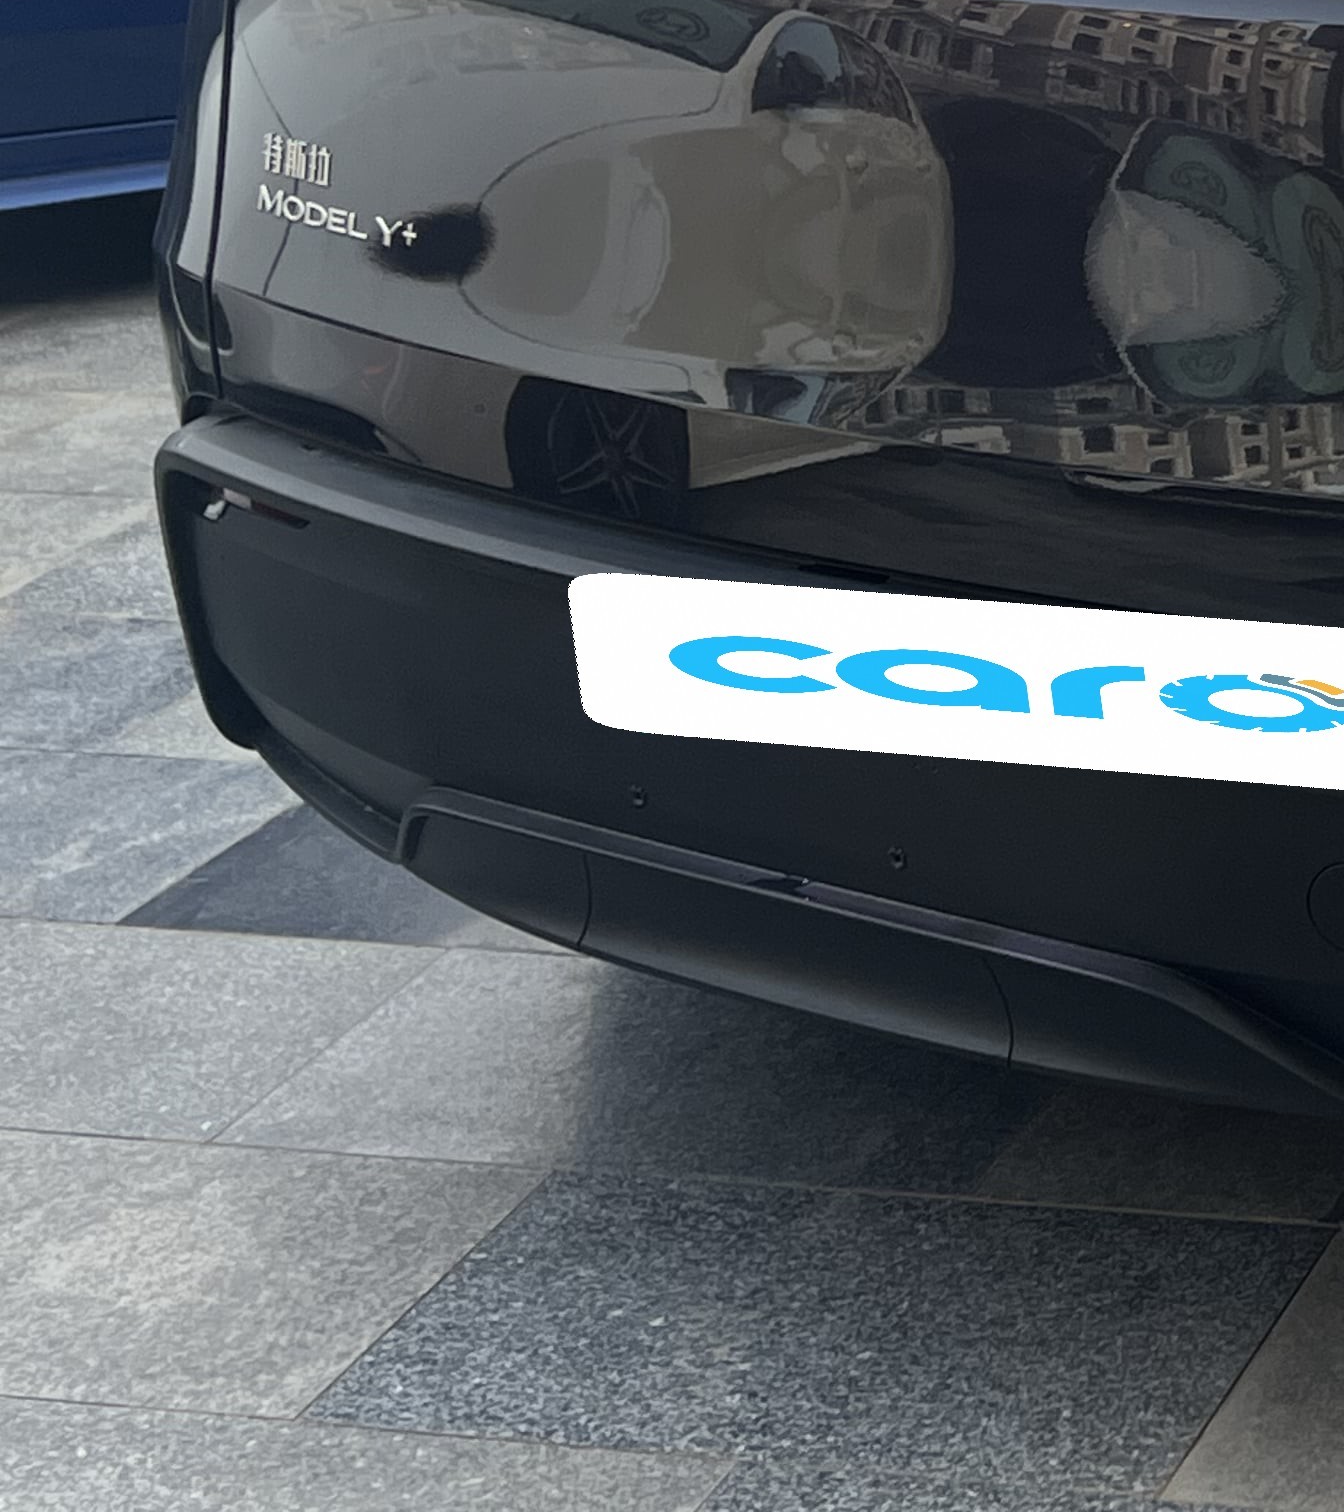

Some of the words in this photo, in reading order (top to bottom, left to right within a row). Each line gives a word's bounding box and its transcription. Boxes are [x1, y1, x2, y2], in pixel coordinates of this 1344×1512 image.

[262, 132, 333, 186] 特斯拉
[257, 184, 368, 240] MODEL
